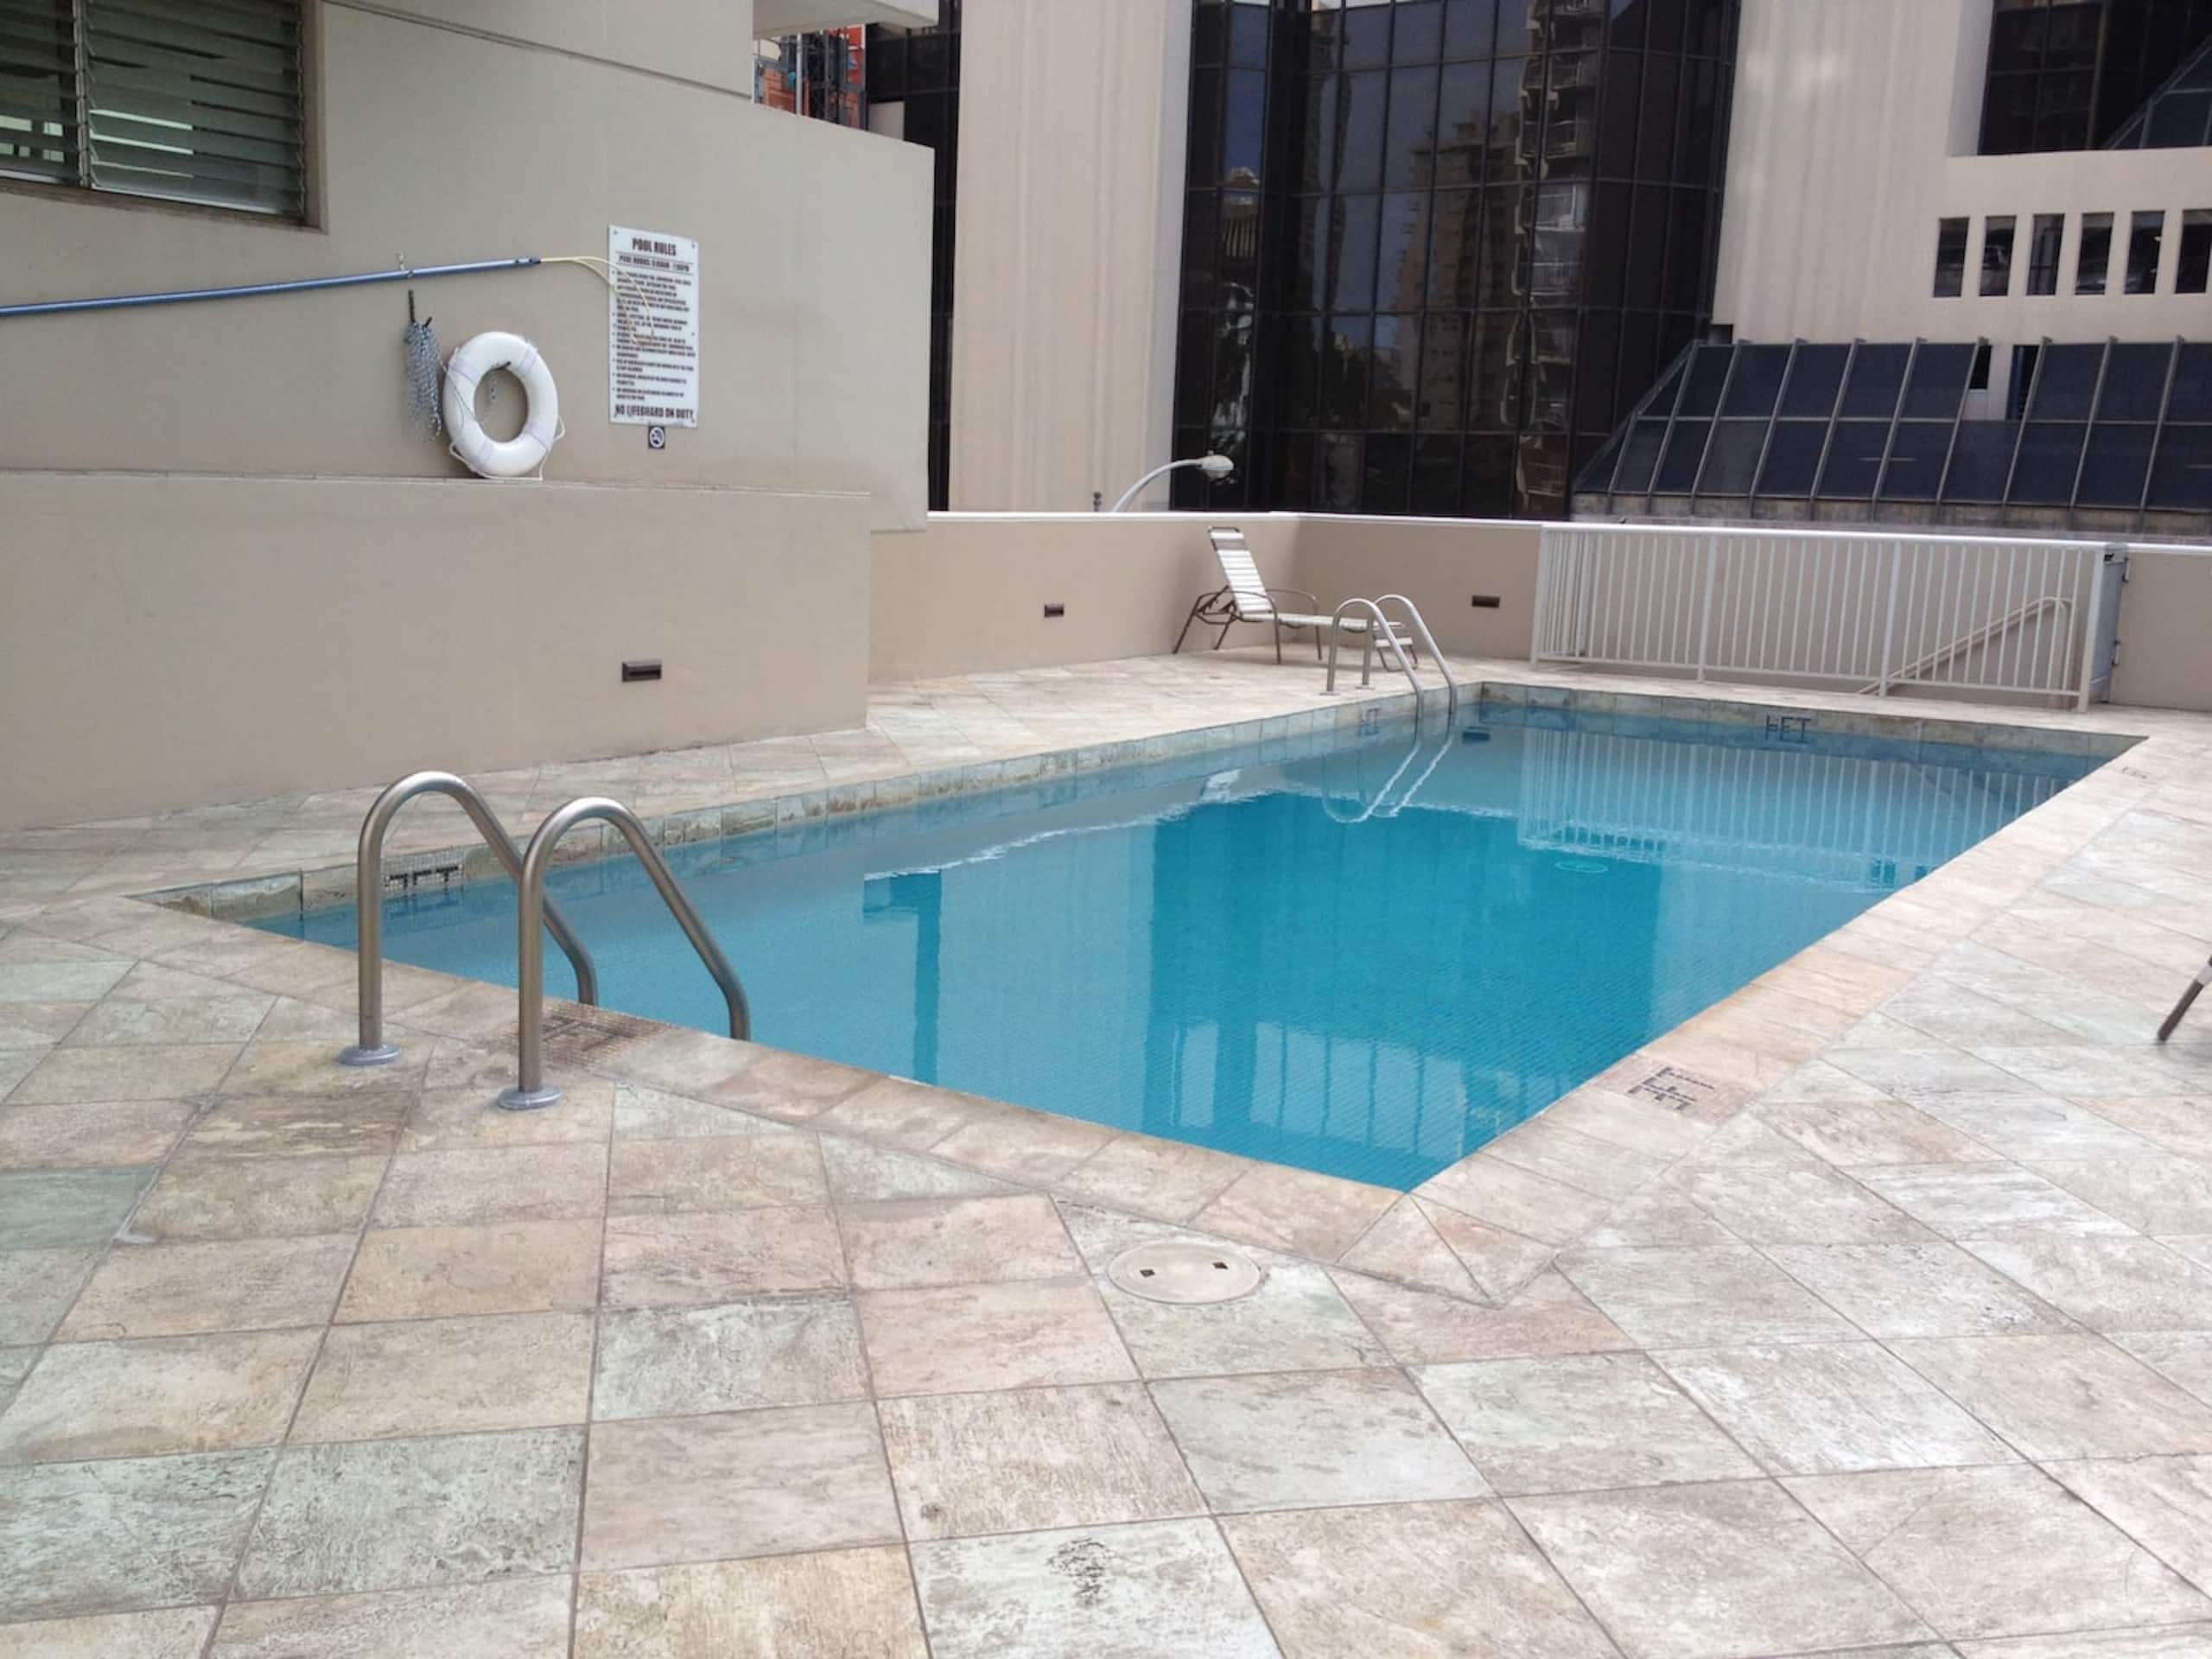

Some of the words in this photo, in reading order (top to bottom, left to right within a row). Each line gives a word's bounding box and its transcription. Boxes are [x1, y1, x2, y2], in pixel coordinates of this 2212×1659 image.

[632, 238, 652, 252] POOL
[654, 241, 677, 256] RULES
[615, 404, 625, 415] NO
[626, 405, 664, 417] LIFEGUARD
[665, 408, 675, 417] ON
[676, 408, 694, 419] DUTY
